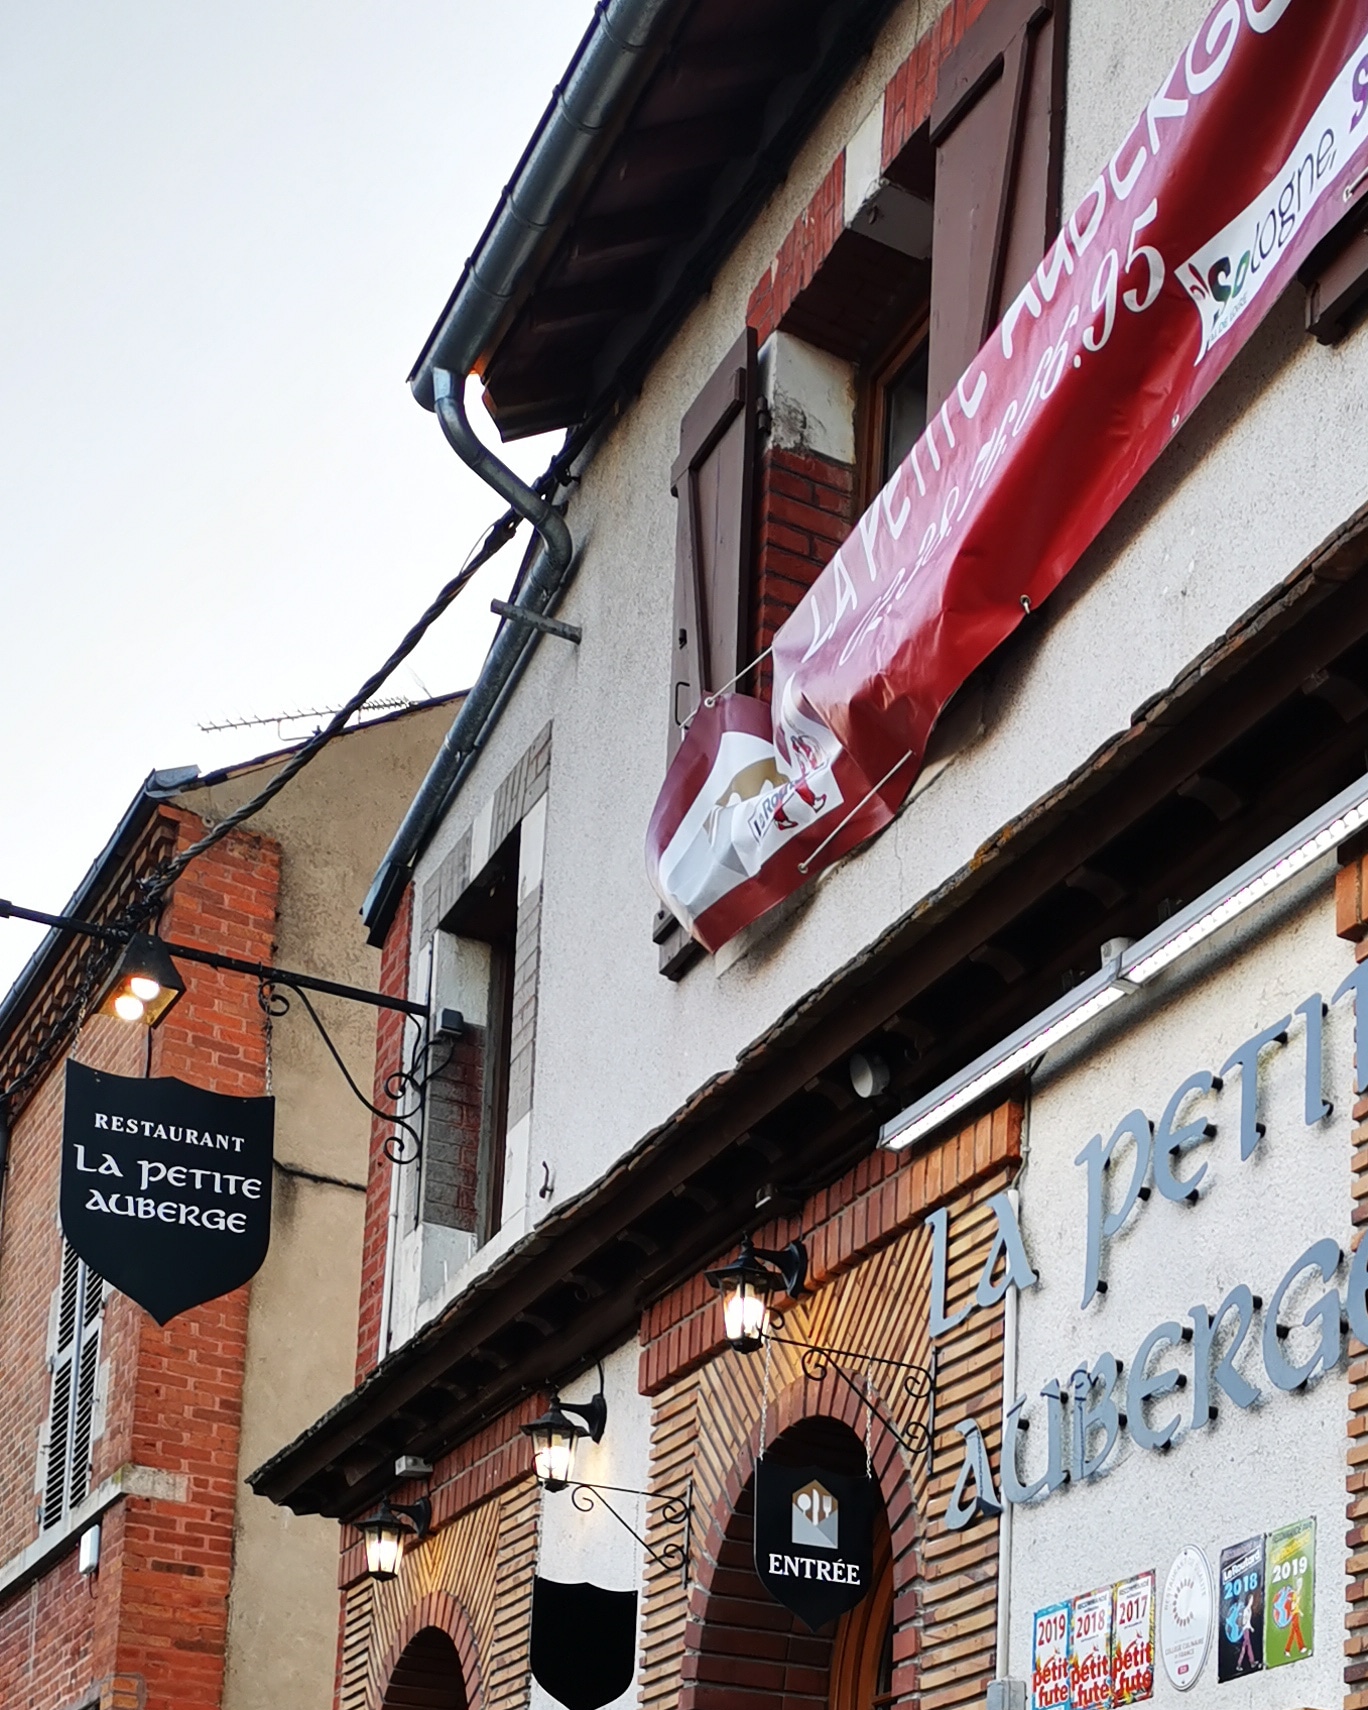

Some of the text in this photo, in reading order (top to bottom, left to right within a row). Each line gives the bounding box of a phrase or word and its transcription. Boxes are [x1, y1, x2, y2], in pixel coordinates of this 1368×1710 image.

[94, 1113, 245, 1152] RESTAURANT
[73, 1143, 262, 1199] LA PETITE
[85, 1188, 248, 1234] AUBERGE
[924, 1192, 1038, 1339] LA
[768, 1552, 861, 1586] ENTRÉE
[1271, 1556, 1308, 1583] 2019
[1223, 1572, 1258, 1600] 2018
[1076, 1609, 1106, 1639] 2018
[1118, 1594, 1148, 1625] 2017
[1038, 1613, 1066, 1646] 2019
